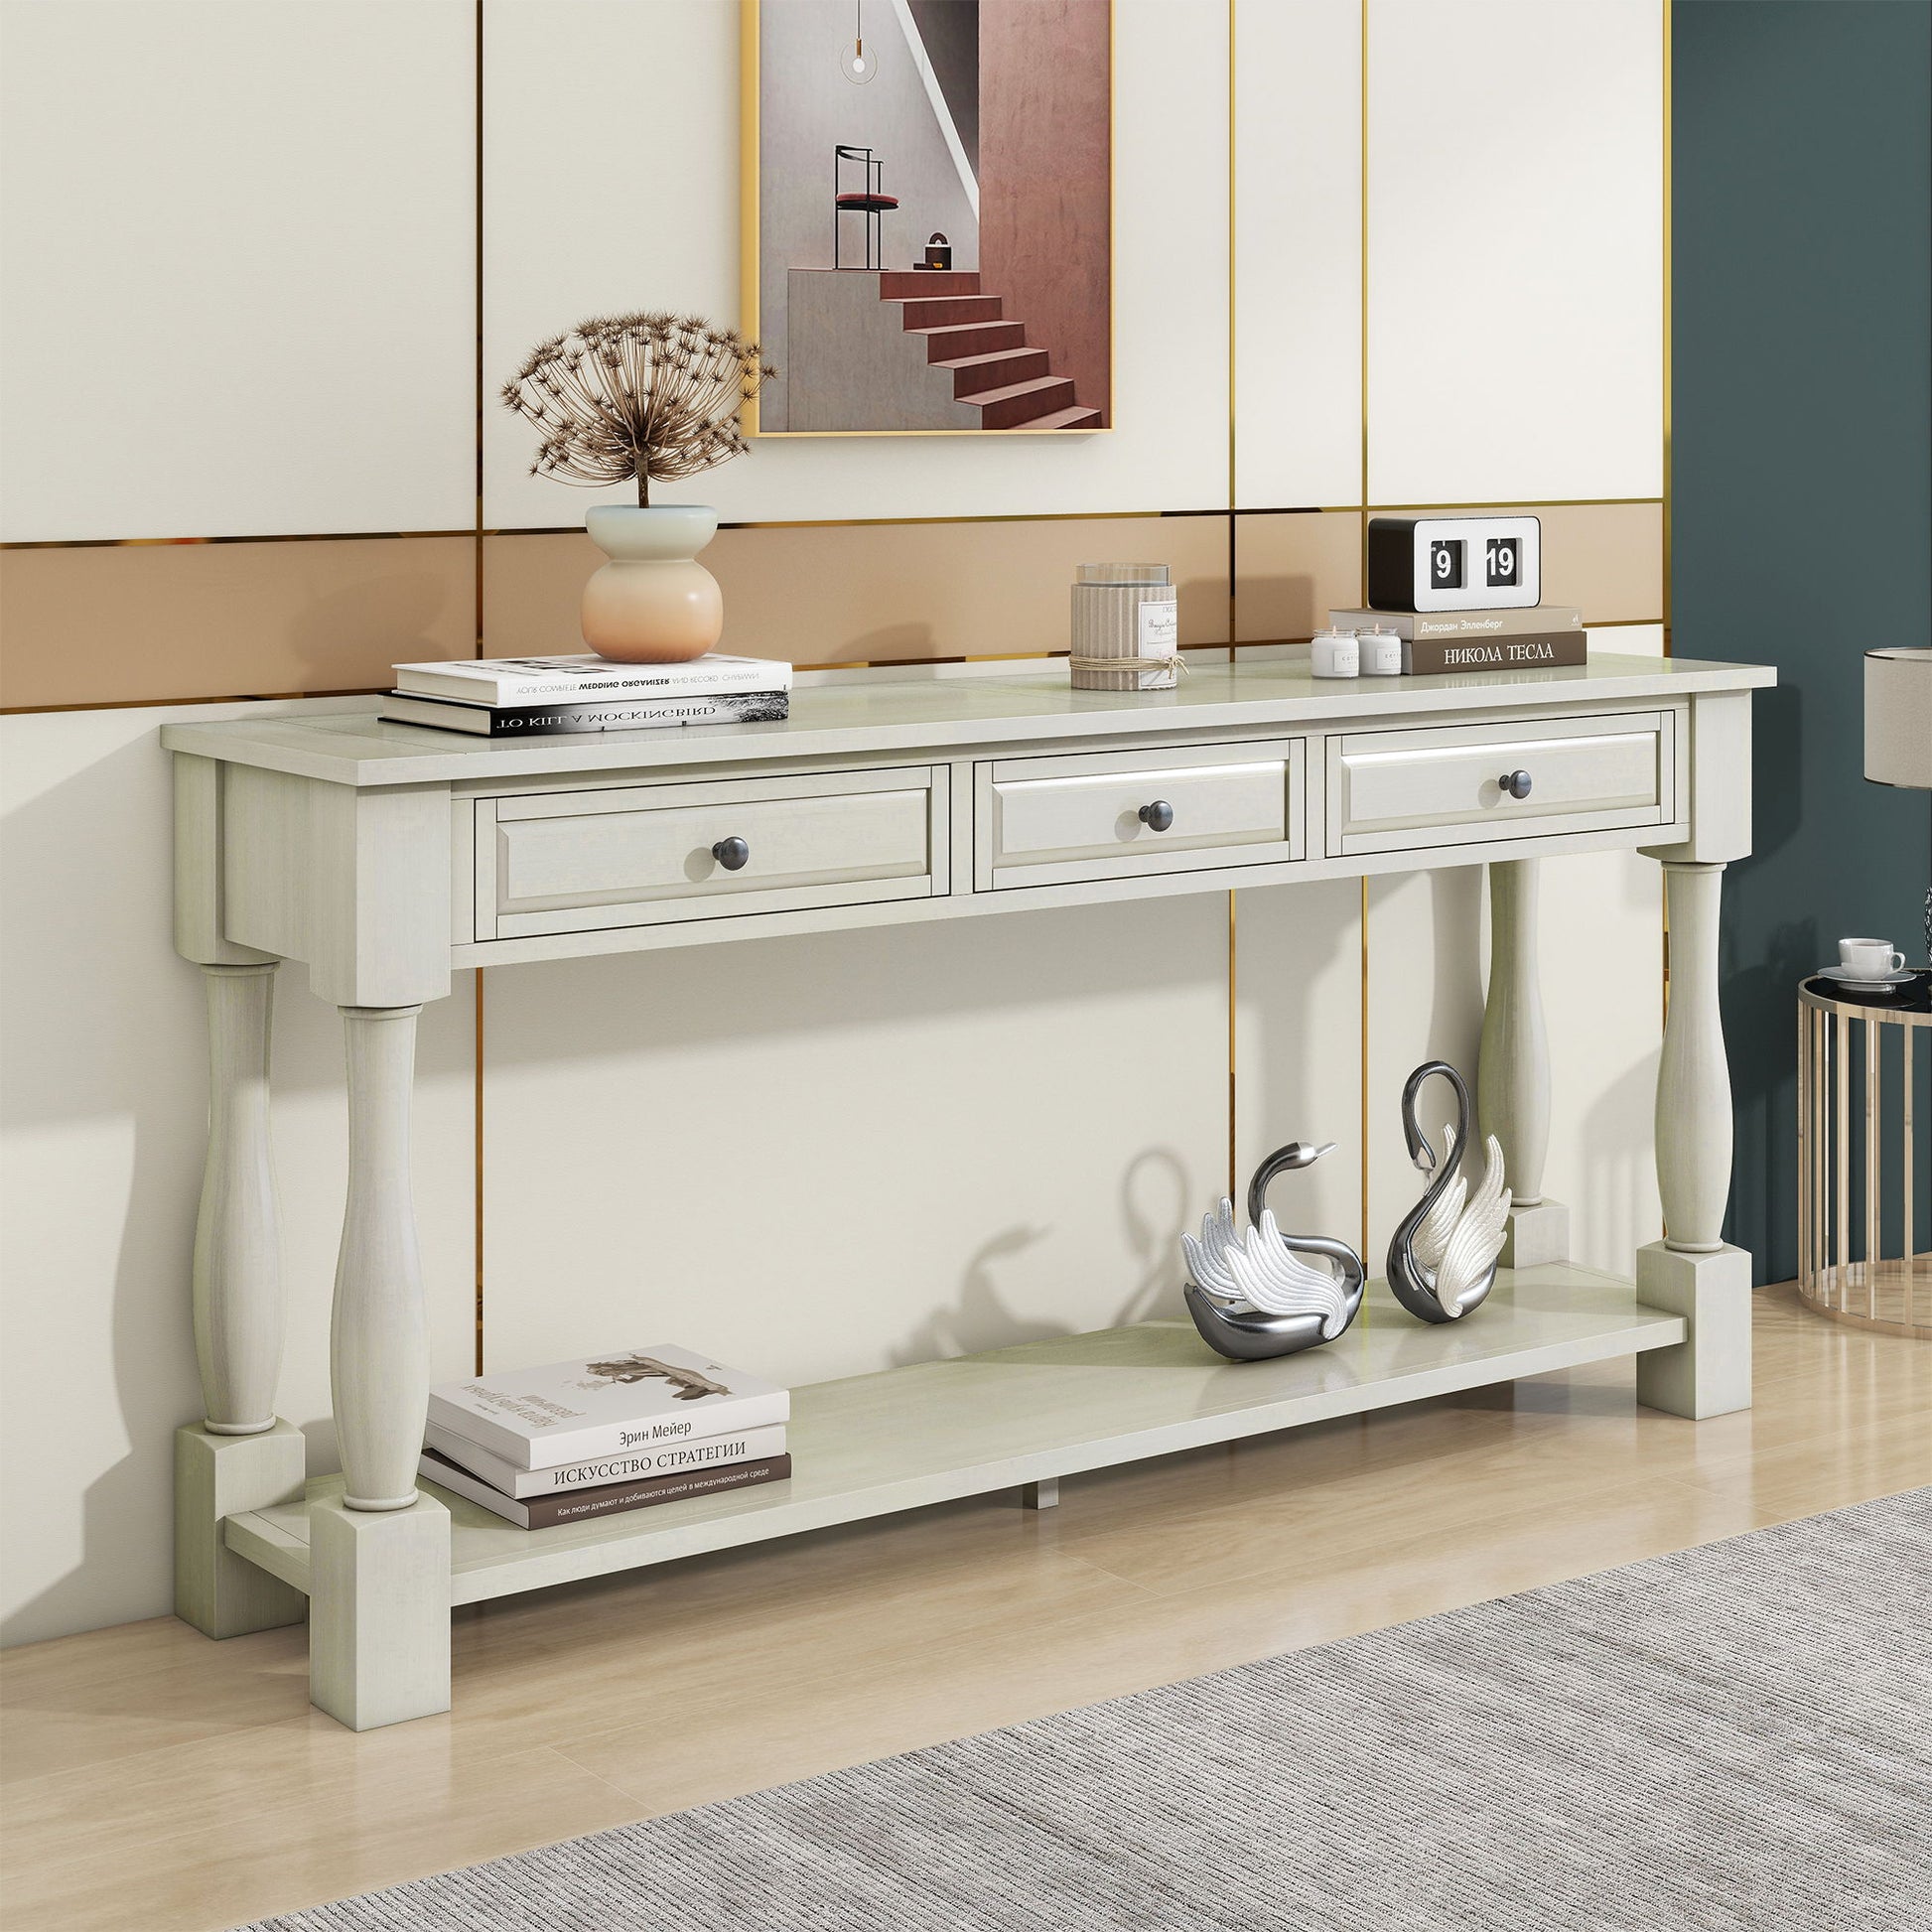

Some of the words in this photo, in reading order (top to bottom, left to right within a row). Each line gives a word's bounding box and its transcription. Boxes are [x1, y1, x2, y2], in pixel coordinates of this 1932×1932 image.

[1436, 549, 1451, 579] 9
[1486, 547, 1514, 576] 19
[1421, 621, 1457, 633] Джордан
[1460, 619, 1503, 630] Элленберг
[1444, 646, 1503, 664] НИКОЛА
[1506, 642, 1555, 661] ТЕСЛА
[620, 1429, 649, 1448] Эрин
[652, 1421, 692, 1440] Мейер
[554, 1456, 652, 1485] ИСКУССТВО
[656, 1442, 747, 1467] СТРАТЕГИИ
[557, 1508, 571, 1517] Как
[571, 1504, 591, 1514] люди
[591, 1498, 619, 1511] думают
[624, 1488, 666, 1504] добиваются
[666, 1482, 688, 1495] целей
[694, 1471, 749, 1489] международной
[750, 1467, 769, 1479] среде
